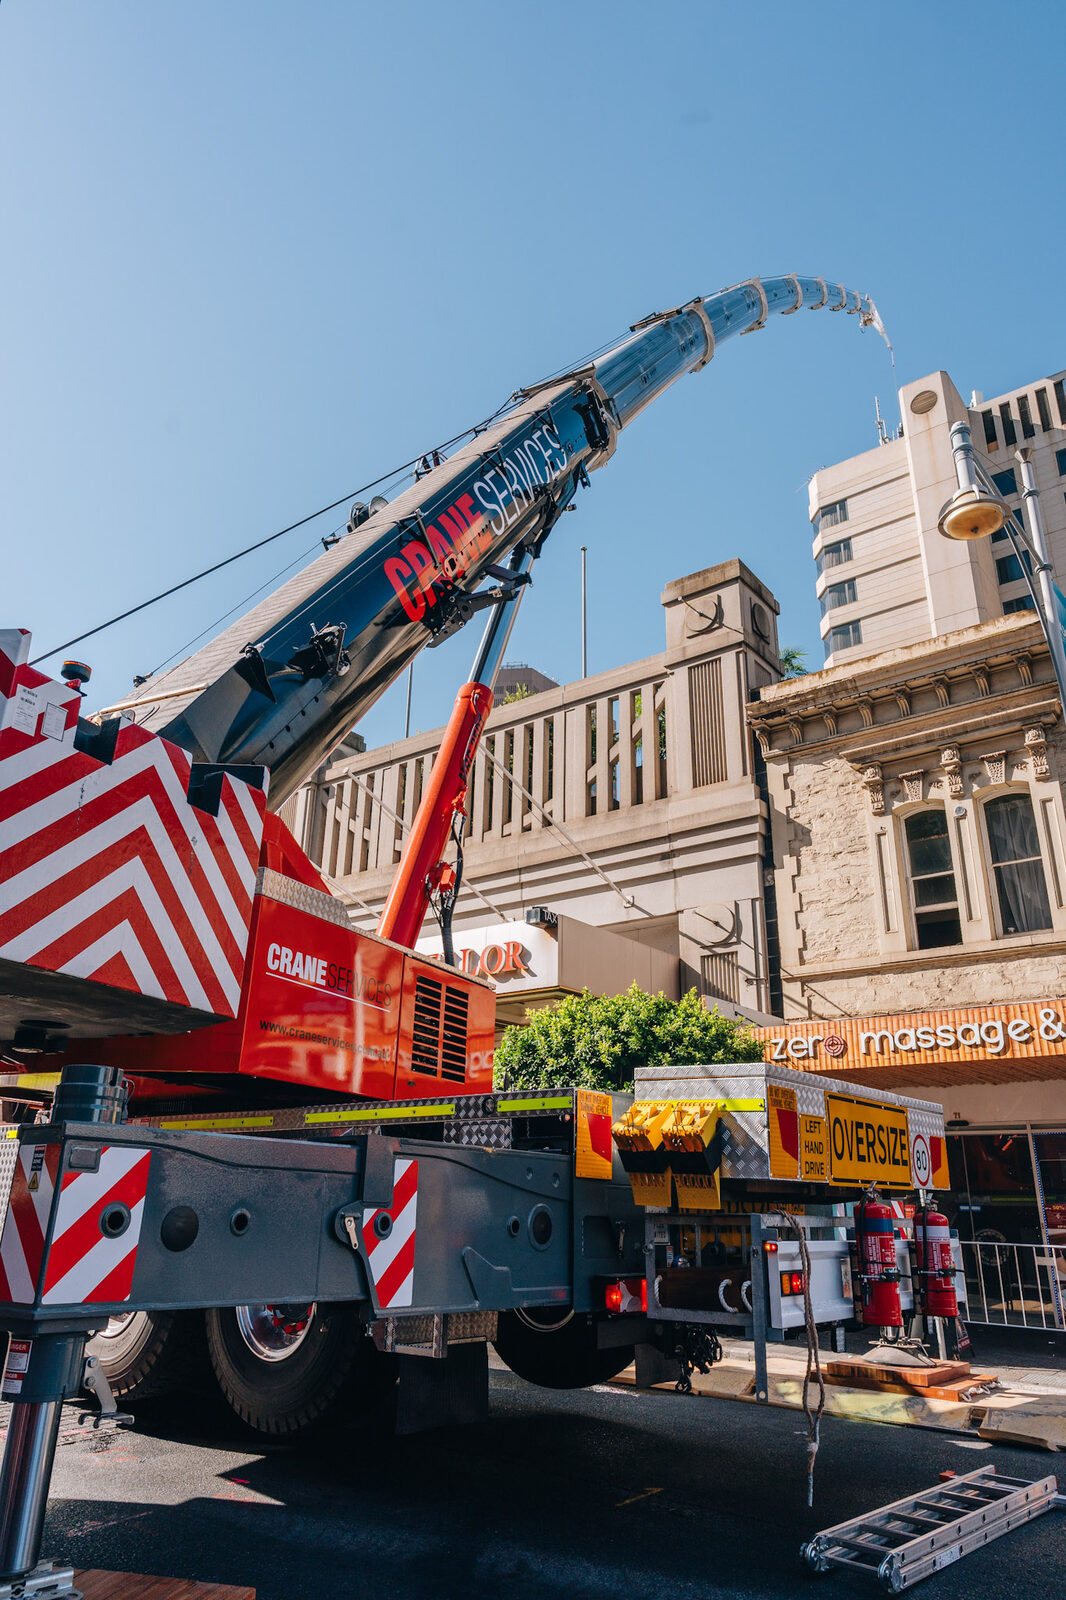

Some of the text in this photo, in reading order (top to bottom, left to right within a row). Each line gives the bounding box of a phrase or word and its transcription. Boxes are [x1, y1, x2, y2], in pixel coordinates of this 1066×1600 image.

[384, 424, 568, 622] CRANE SERVICES
[542, 909, 559, 924] TAX
[267, 942, 392, 1007] CRANE SERVICES
[259, 1019, 388, 1059] www.craneservices.com.au
[861, 1018, 1031, 1054] massage
[1040, 1008, 1066, 1040] &
[805, 1120, 822, 1134] LEFT
[832, 1116, 908, 1167] OVERSIZE
[804, 1140, 824, 1155] HAND
[915, 1149, 928, 1171] 80
[804, 1161, 825, 1176] DRIVE
